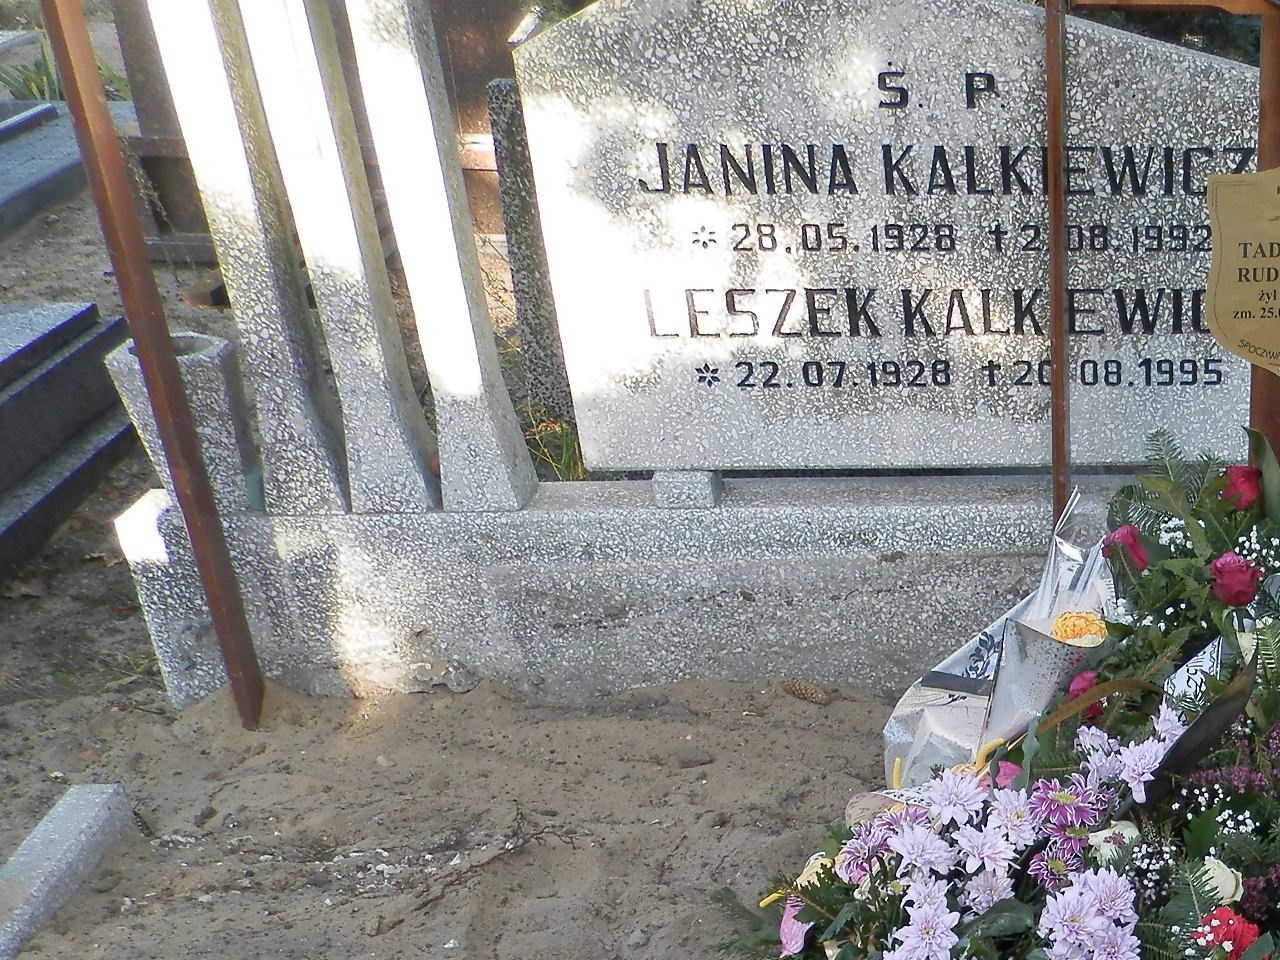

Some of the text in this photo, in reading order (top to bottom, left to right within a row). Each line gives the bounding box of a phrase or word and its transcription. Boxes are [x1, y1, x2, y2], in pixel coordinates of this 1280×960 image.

[638, 142, 859, 195] JANINA
[731, 223, 957, 253] 28.05.1928
[644, 287, 1213, 339] LESZEK KALKEWIC
[1233, 309, 1256, 319] zm.
[735, 358, 1223, 389] 22.07.1928 2008.1995
